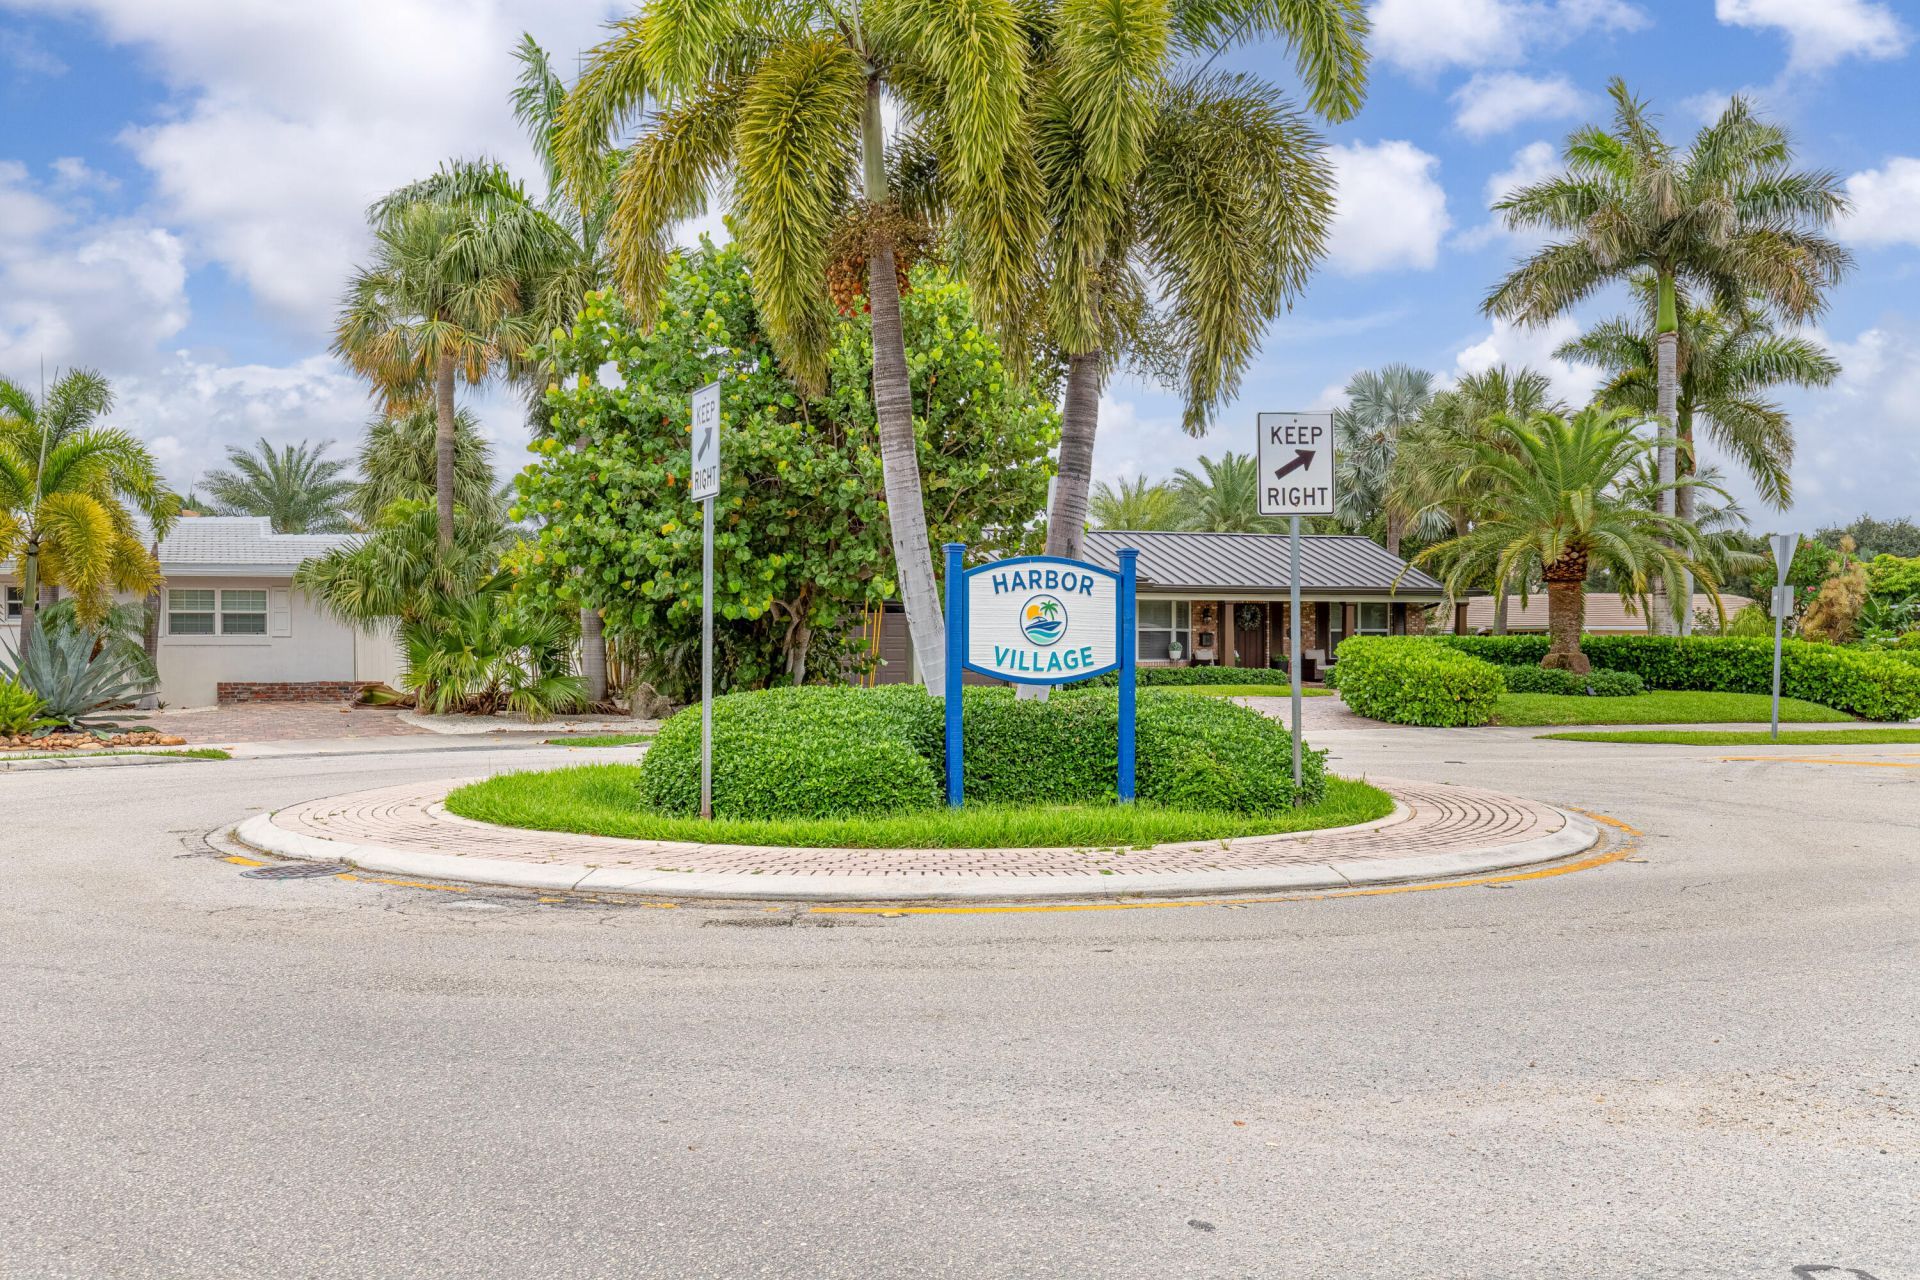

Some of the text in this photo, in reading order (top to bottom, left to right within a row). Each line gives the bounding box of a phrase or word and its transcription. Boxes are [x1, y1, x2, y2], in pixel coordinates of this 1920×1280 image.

[696, 400, 715, 426] KEEP
[1271, 426, 1323, 445] KEEP
[694, 465, 717, 491] RIGHT
[1268, 487, 1328, 506] RIGHT
[992, 569, 1094, 596] HARBOR
[994, 645, 1094, 672] VILLAGE
